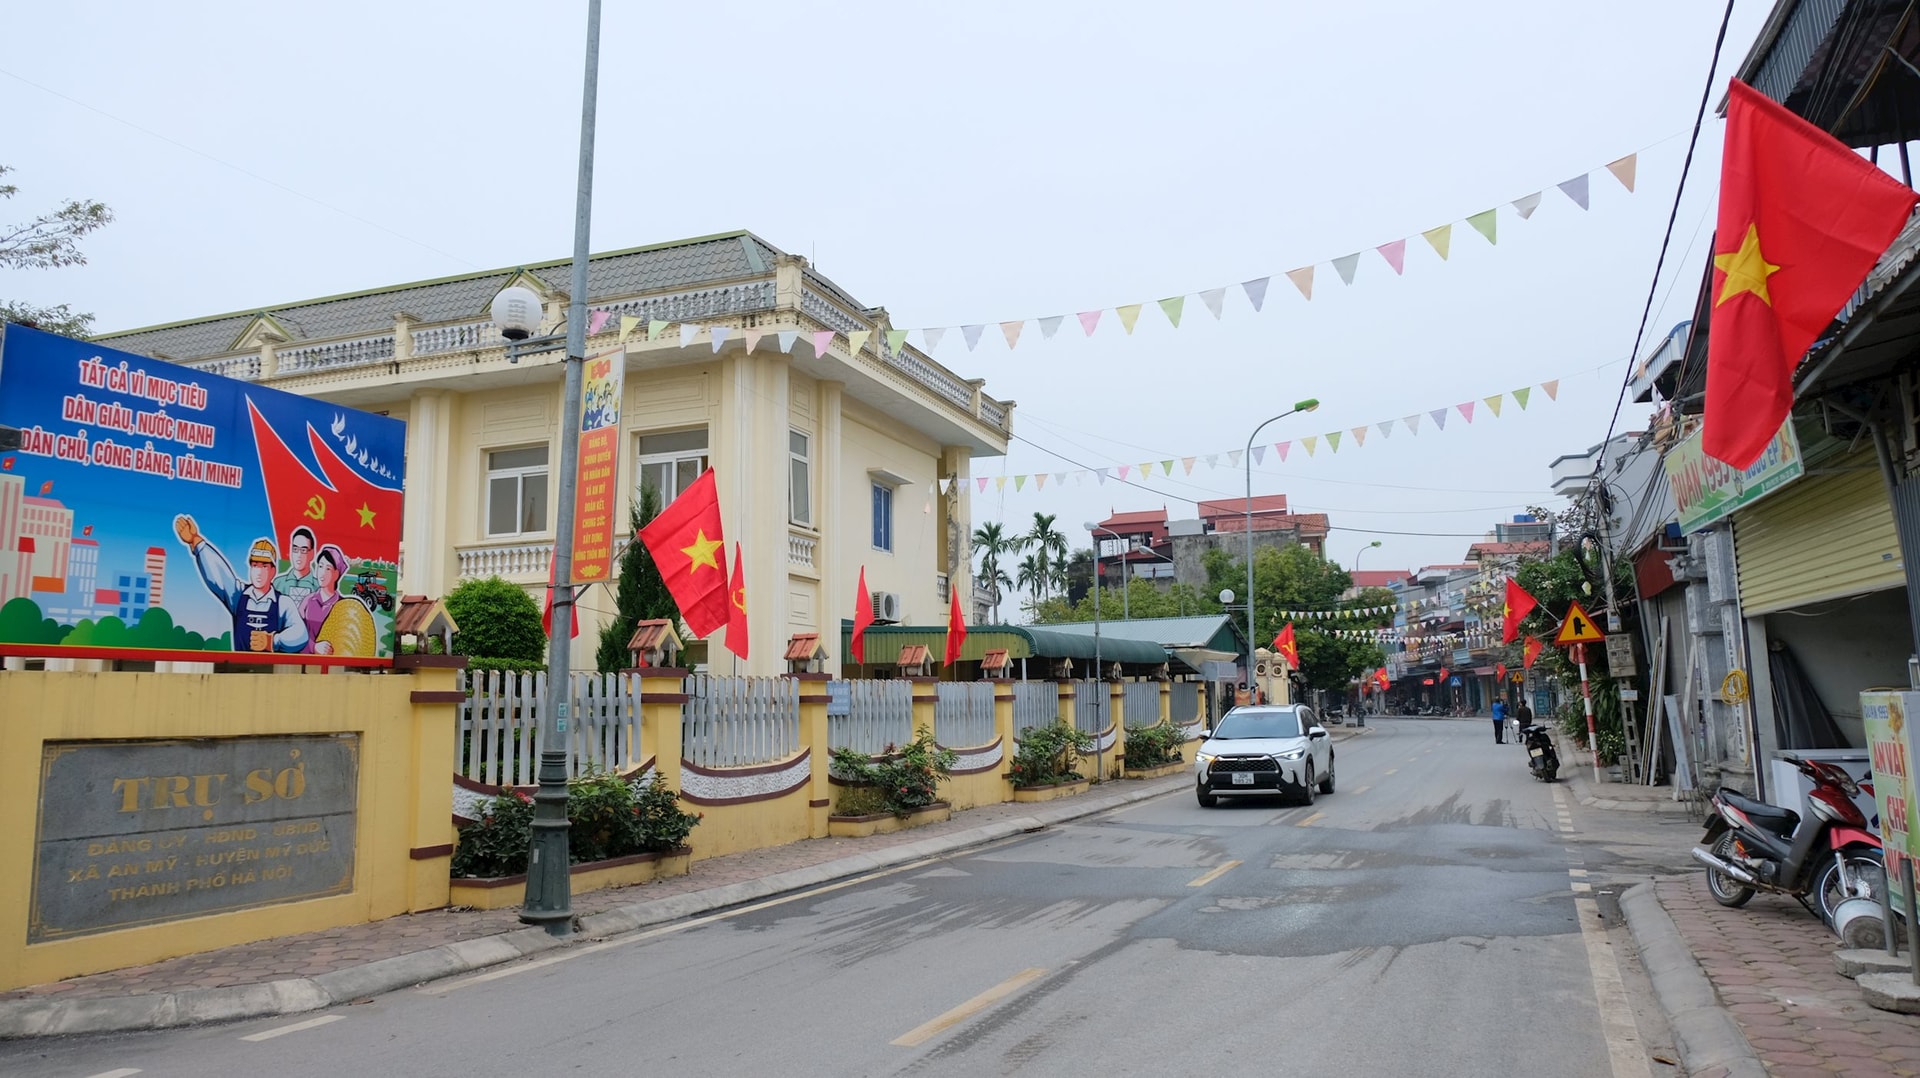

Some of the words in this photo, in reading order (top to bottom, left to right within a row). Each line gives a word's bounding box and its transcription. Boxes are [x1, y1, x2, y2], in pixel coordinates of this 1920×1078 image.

[80, 357, 107, 388] TẤT
[107, 361, 128, 394] CẢ
[130, 369, 145, 397] VÌ
[145, 376, 176, 406] MỤC
[178, 382, 207, 411] TIÊU
[62, 394, 97, 425] DÂN
[97, 402, 134, 436] GIÀU,
[136, 410, 174, 440] NƯỚC
[175, 419, 215, 449] MẠNH
[21, 425, 55, 457] DÂN
[56, 429, 90, 466] CHỦ,
[93, 438, 133, 470] CÔNG
[133, 441, 175, 479] BẰNG,
[176, 453, 204, 482] VĂN
[204, 461, 242, 489] MINH!
[1671, 452, 1704, 514] QUÁN
[112, 774, 228, 821] TRỤ
[244, 749, 306, 805] SỞ
[67, 864, 100, 883] XÃ
[107, 864, 140, 878] AN
[145, 855, 177, 873] MỸ
[196, 847, 260, 867] HUYỆN
[265, 842, 291, 858] MỸ
[297, 838, 330, 855] ĐỨC
[108, 882, 180, 901] THÀNH
[186, 870, 226, 890] PHỐ
[231, 868, 256, 885] HÀ
[262, 865, 293, 881] NỘI
